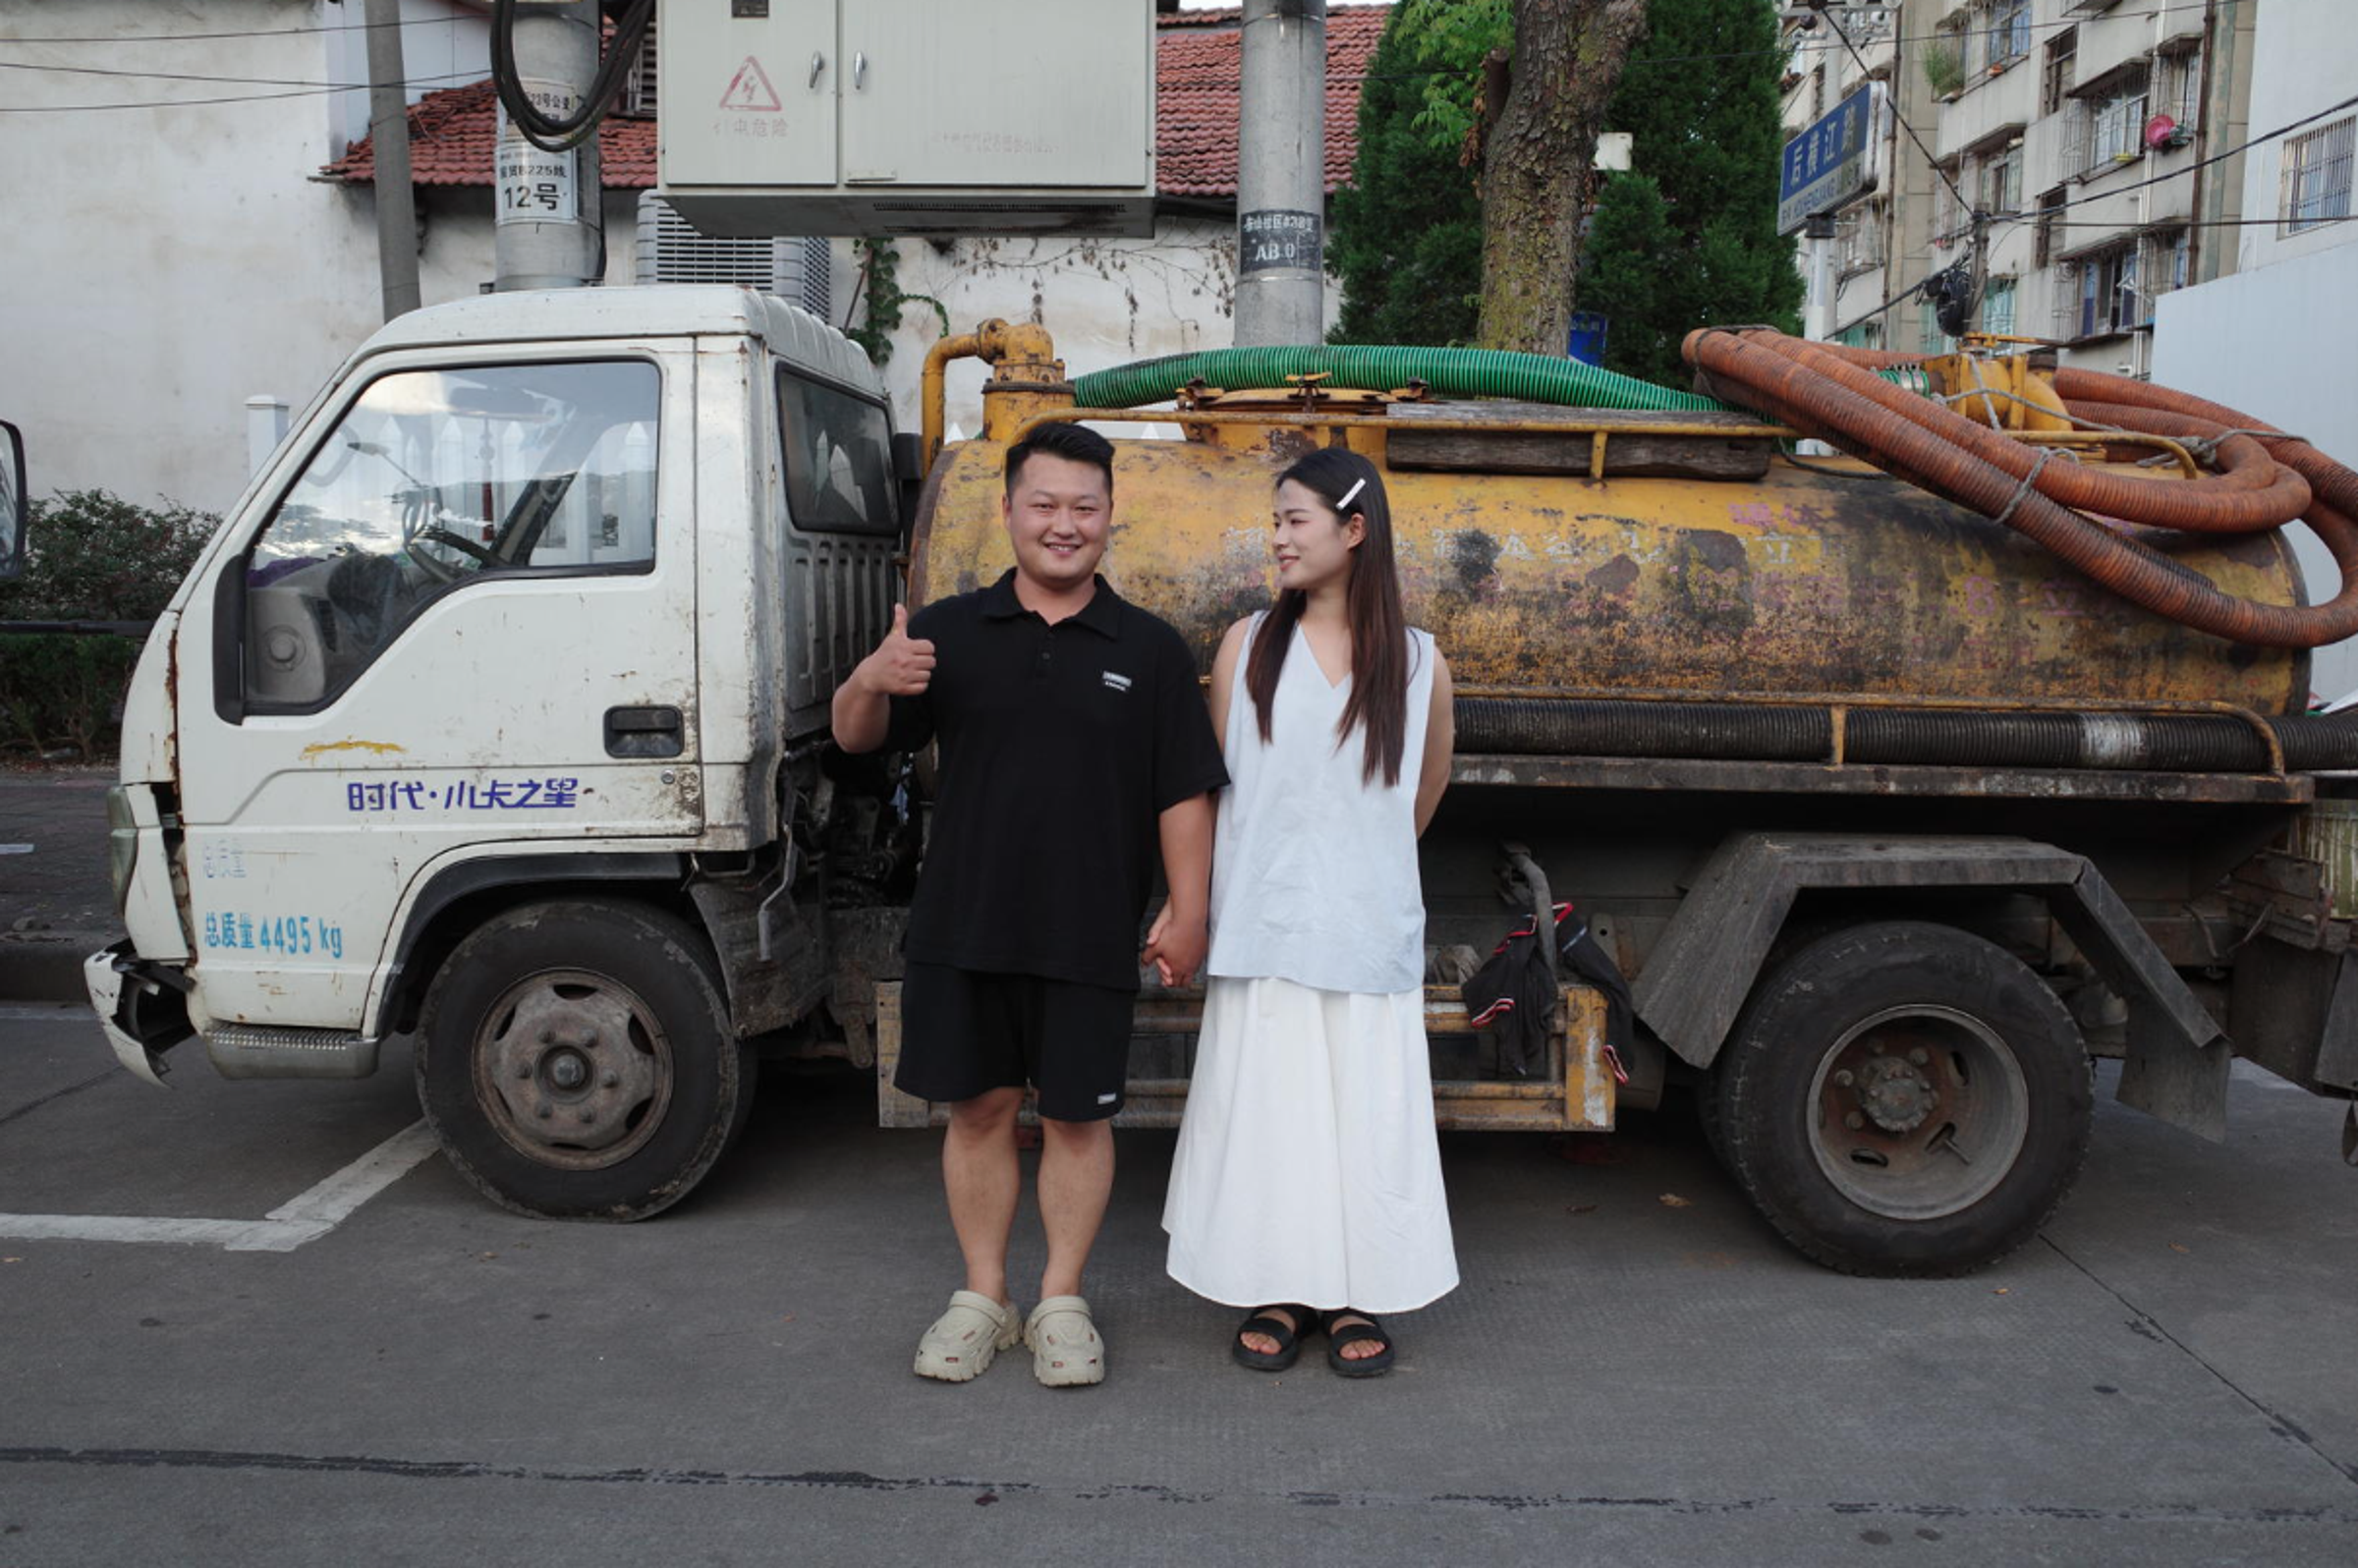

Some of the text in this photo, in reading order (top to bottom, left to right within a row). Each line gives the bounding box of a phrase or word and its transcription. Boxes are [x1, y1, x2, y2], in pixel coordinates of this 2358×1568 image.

[504, 183, 560, 210] 12号
[259, 915, 311, 955] 4495
[317, 916, 343, 959] kg
